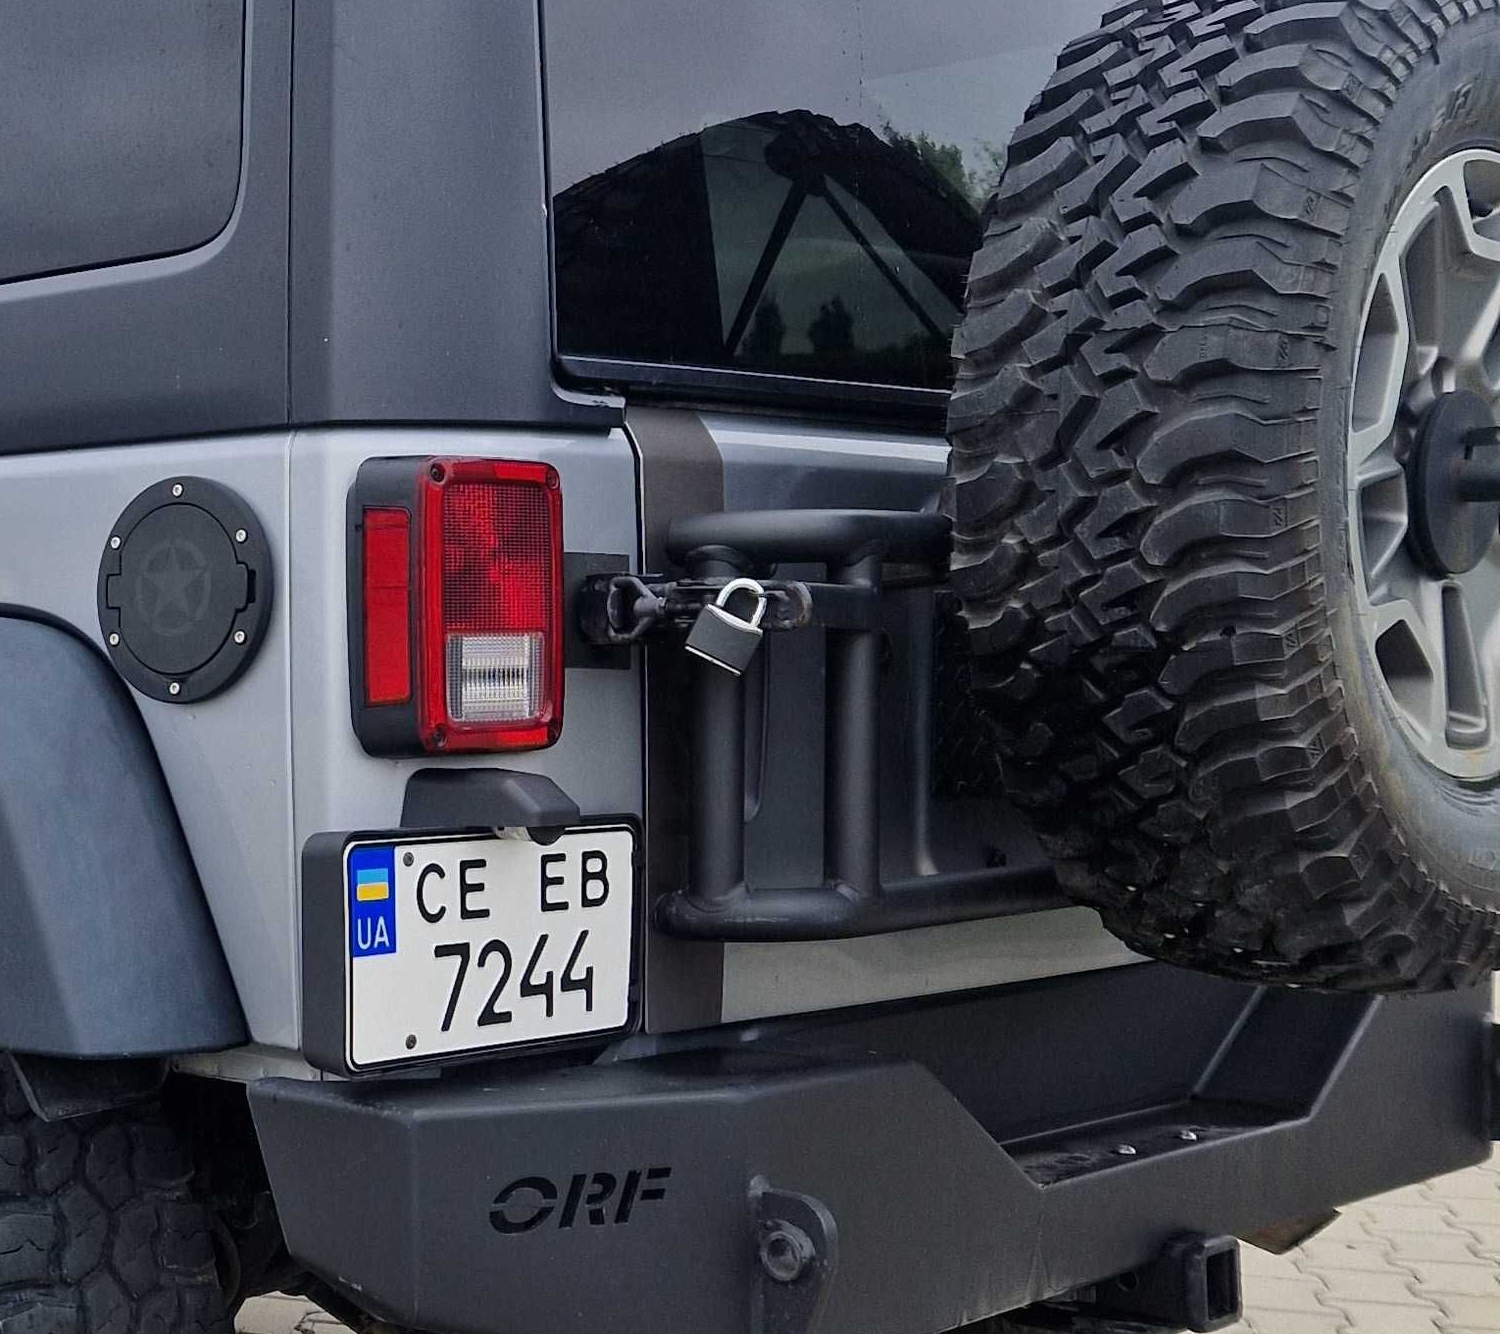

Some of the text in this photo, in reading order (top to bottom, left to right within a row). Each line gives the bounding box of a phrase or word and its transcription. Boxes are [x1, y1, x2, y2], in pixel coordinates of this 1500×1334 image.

[416, 850, 610, 923] CE EB
[357, 915, 390, 950] UA
[434, 930, 594, 1032] 7244
[488, 1167, 672, 1234] ORF
